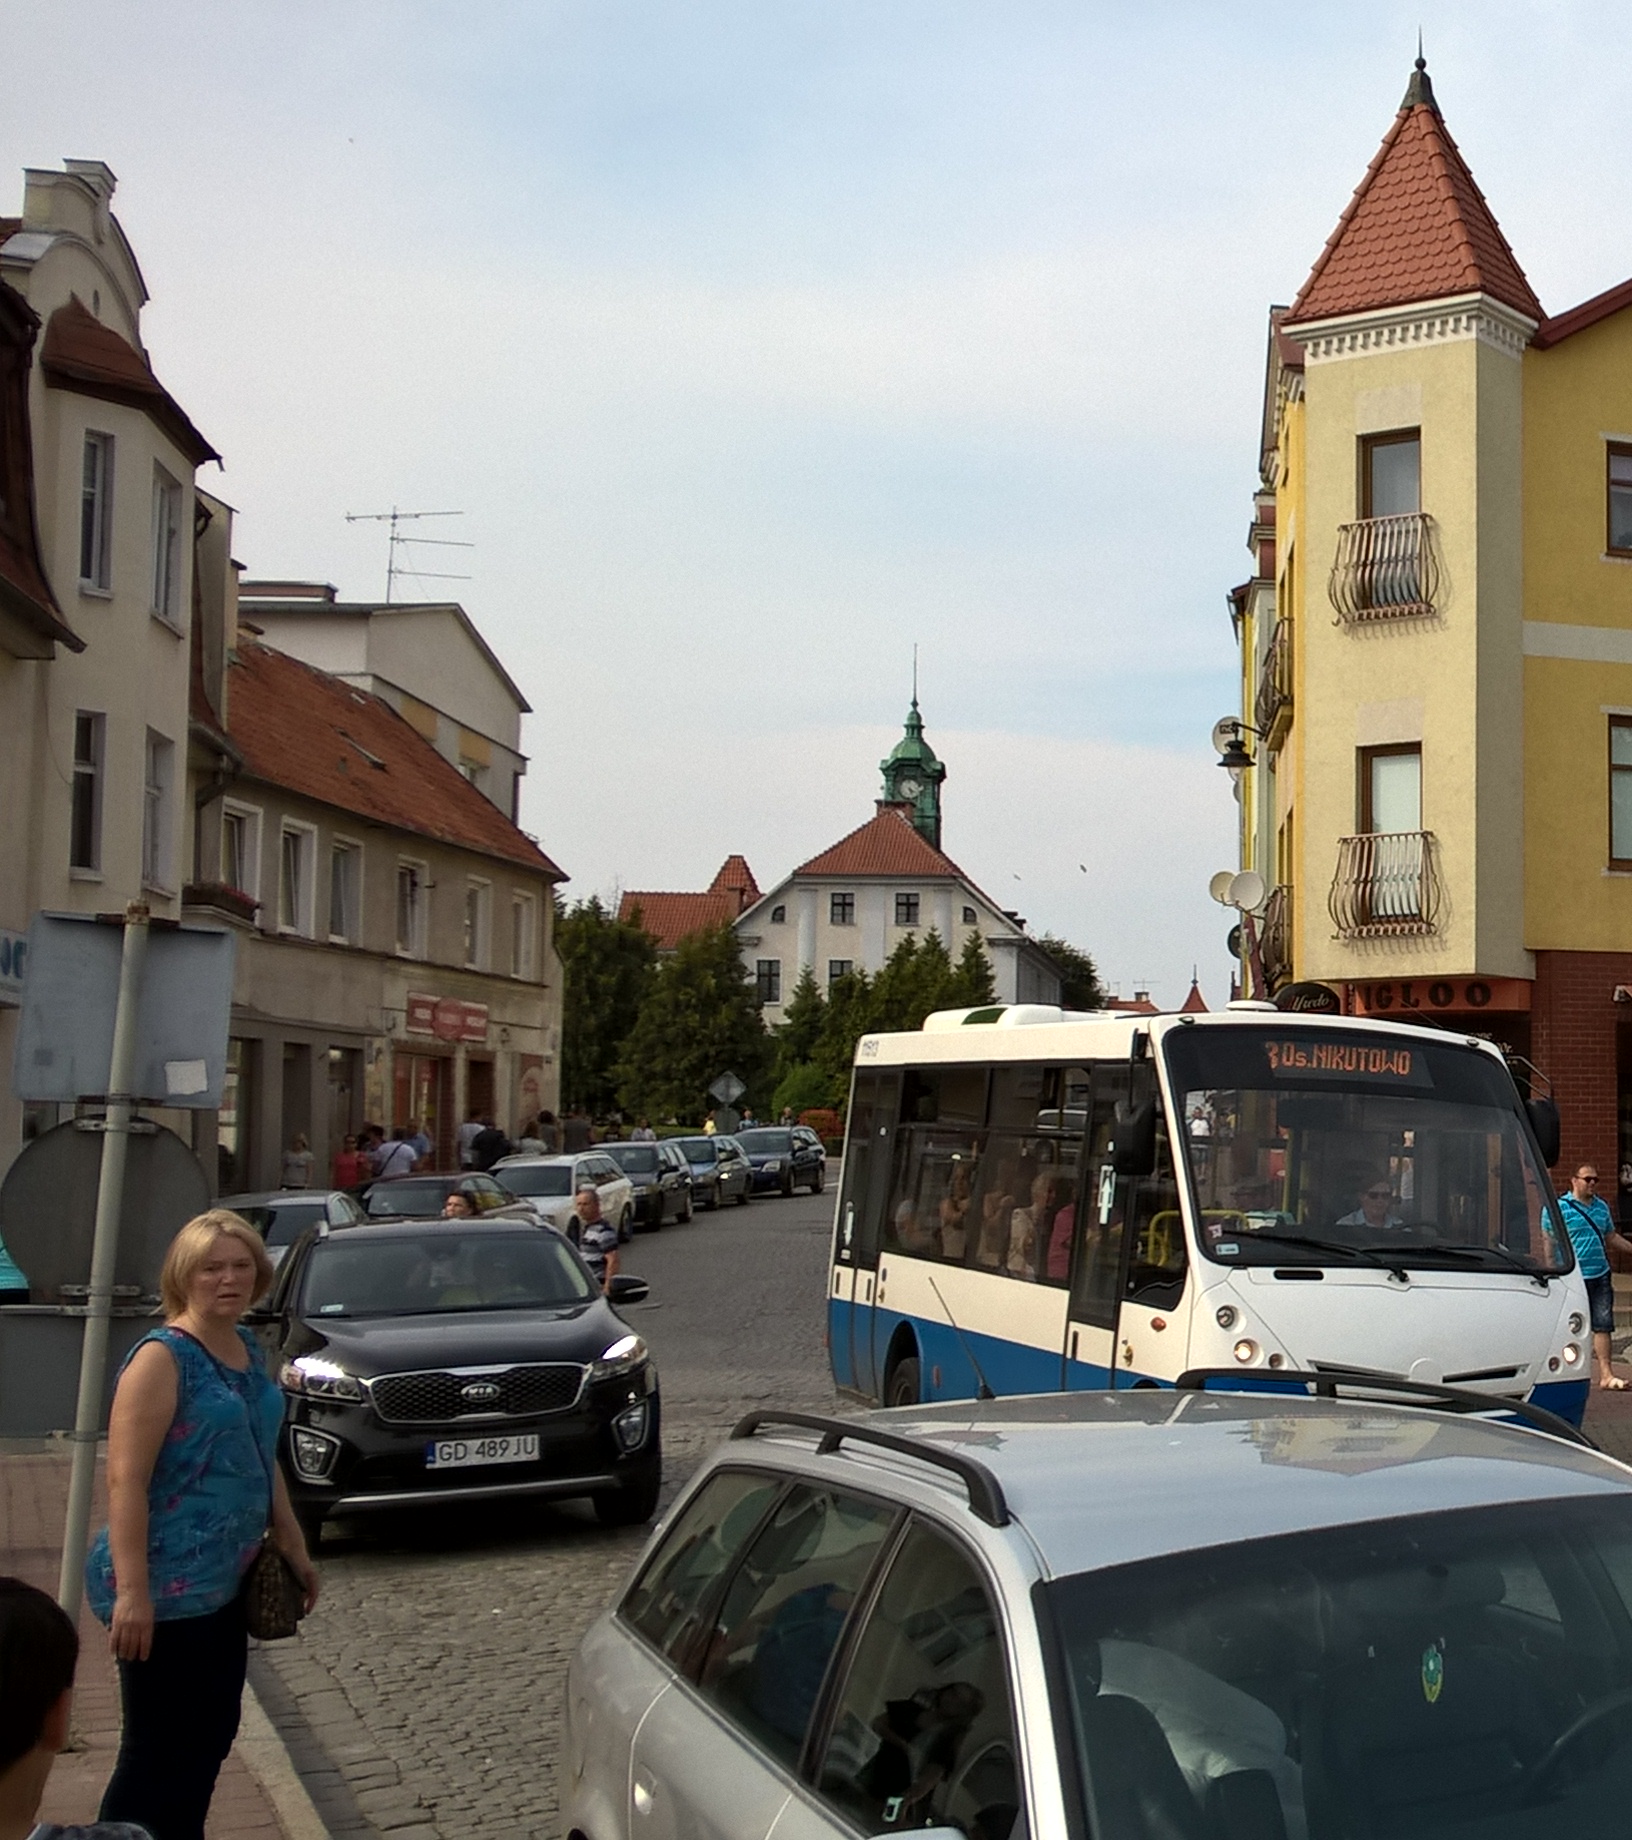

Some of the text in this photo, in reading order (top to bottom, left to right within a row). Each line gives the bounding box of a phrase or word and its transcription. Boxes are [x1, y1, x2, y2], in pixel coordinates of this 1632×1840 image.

[1364, 981, 1491, 1011] IGLOO
[439, 1436, 536, 1461] GD 489 JU
